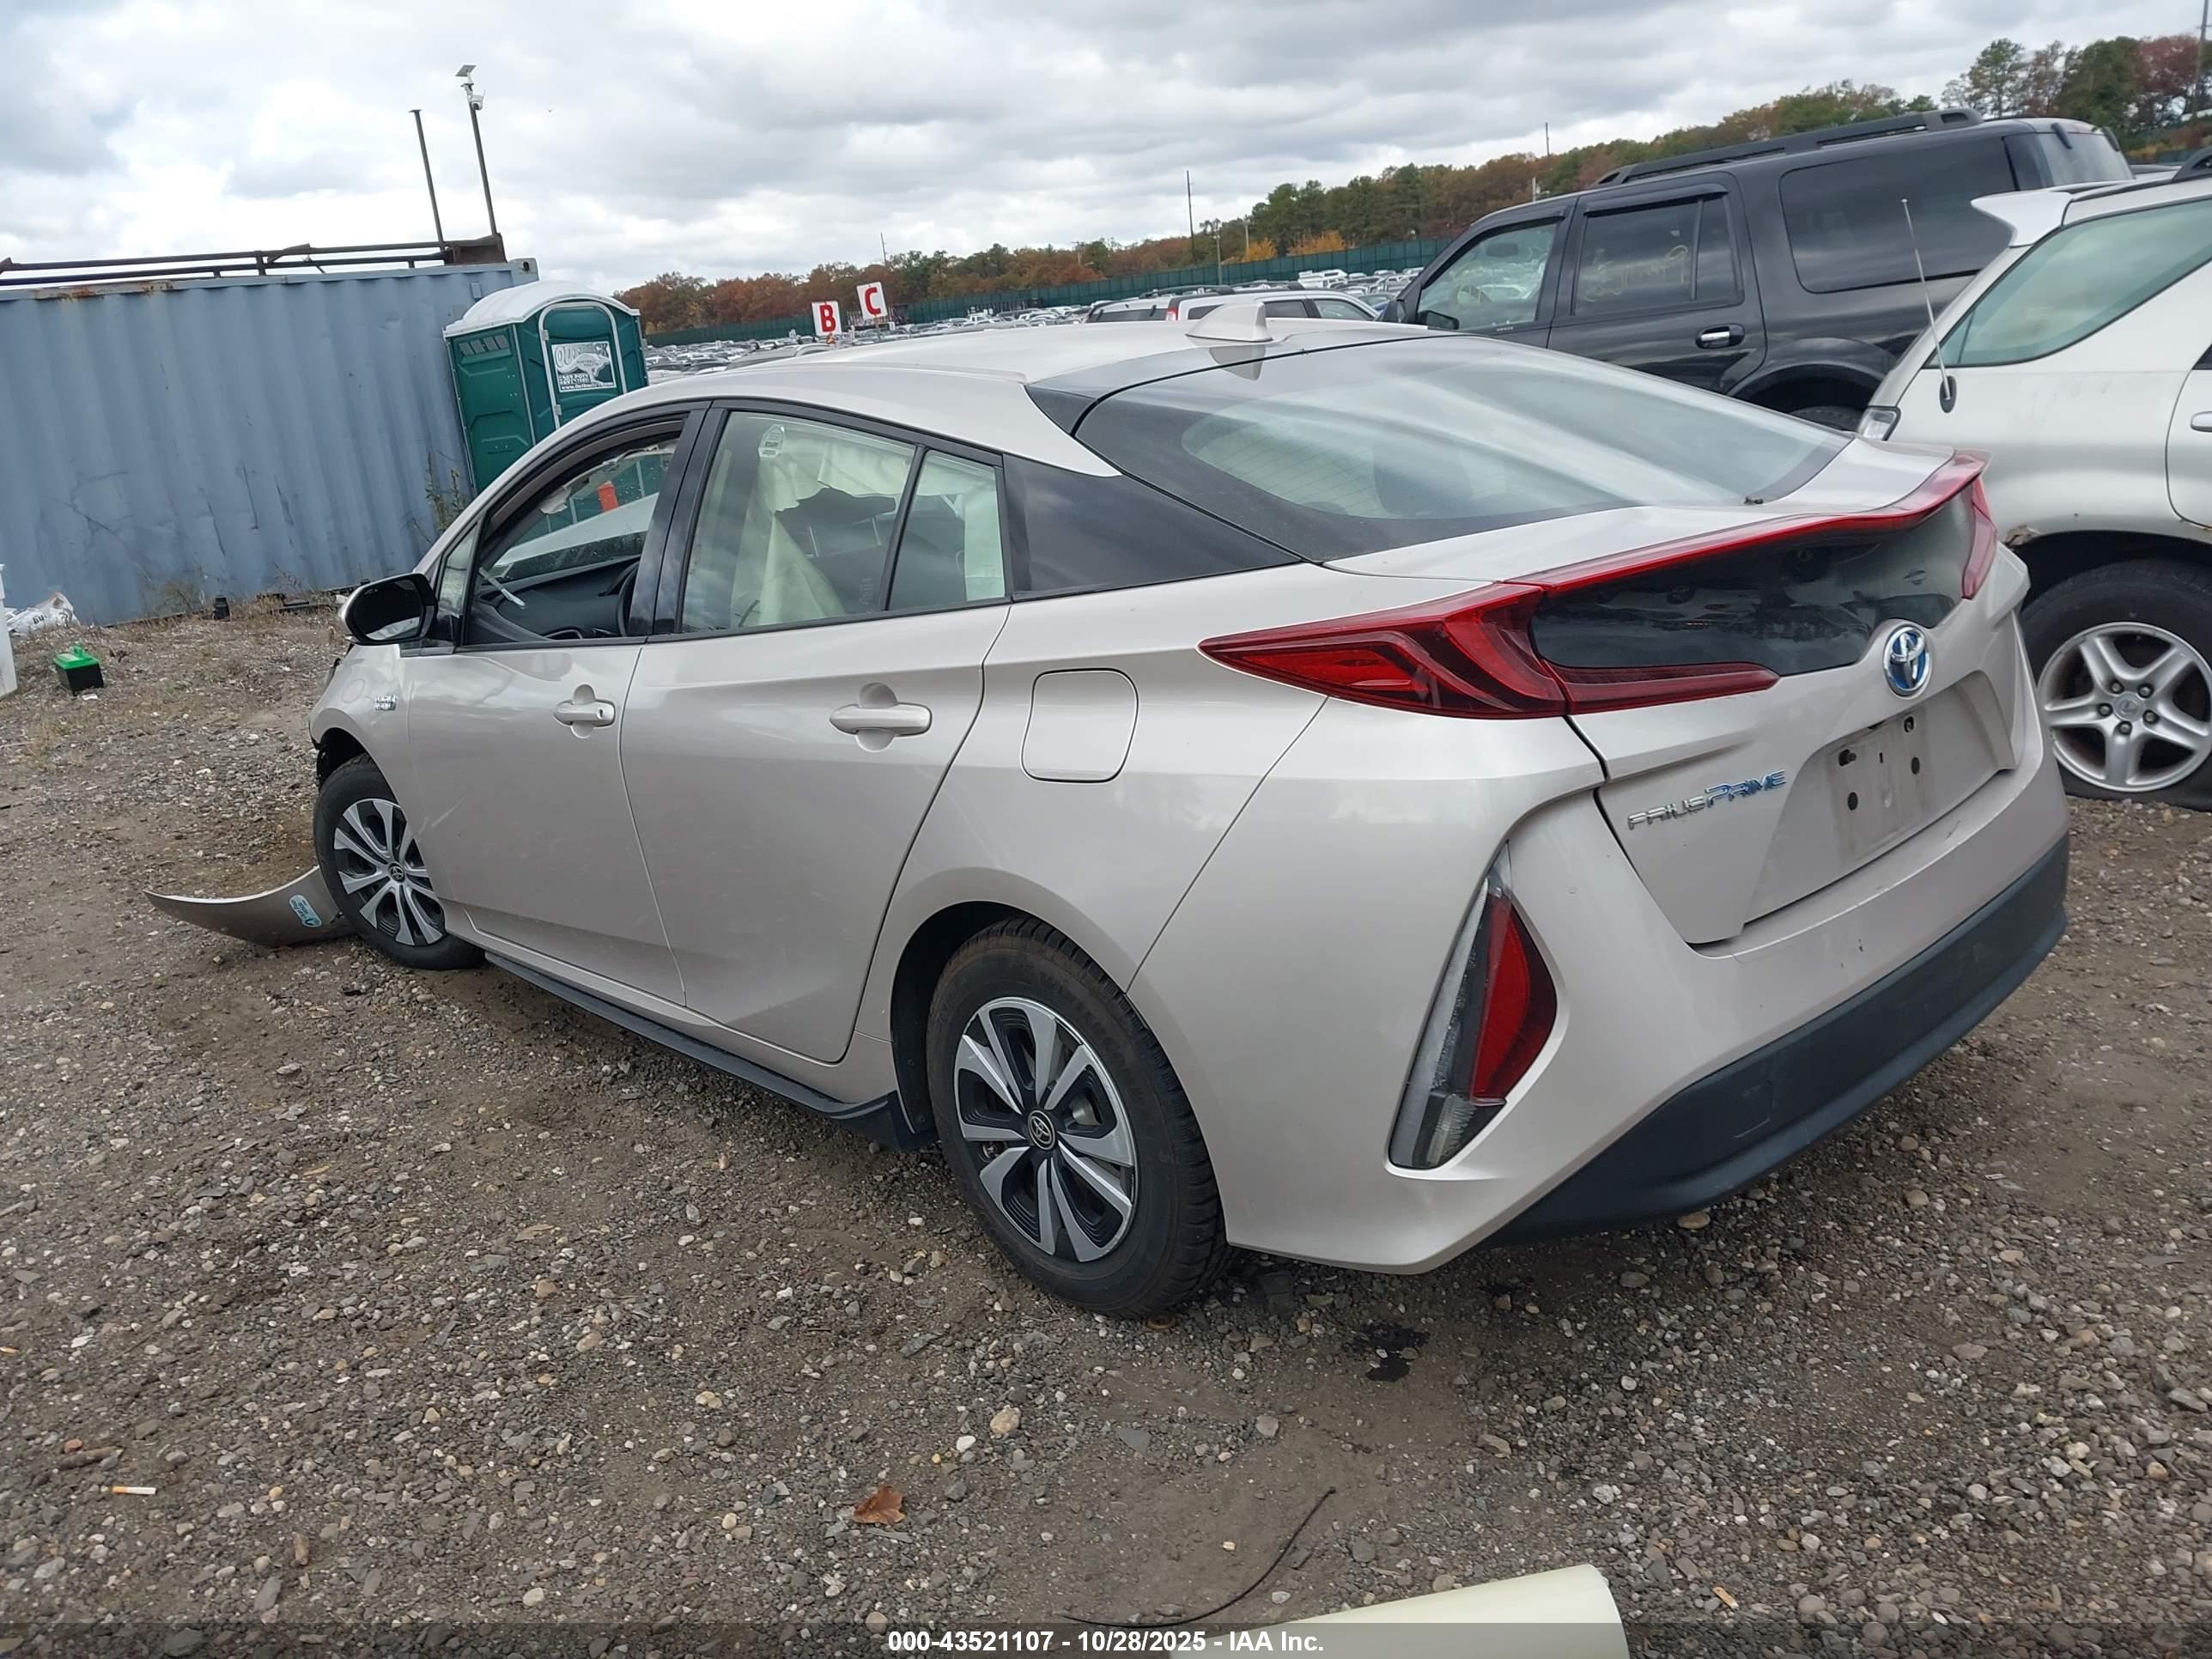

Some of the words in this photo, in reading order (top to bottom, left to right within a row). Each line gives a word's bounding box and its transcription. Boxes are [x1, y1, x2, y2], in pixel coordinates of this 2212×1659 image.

[865, 287, 881, 315] C
[819, 304, 836, 332] B
[1627, 795, 1706, 830] PRIUS
[1705, 769, 1787, 808] PRIME
